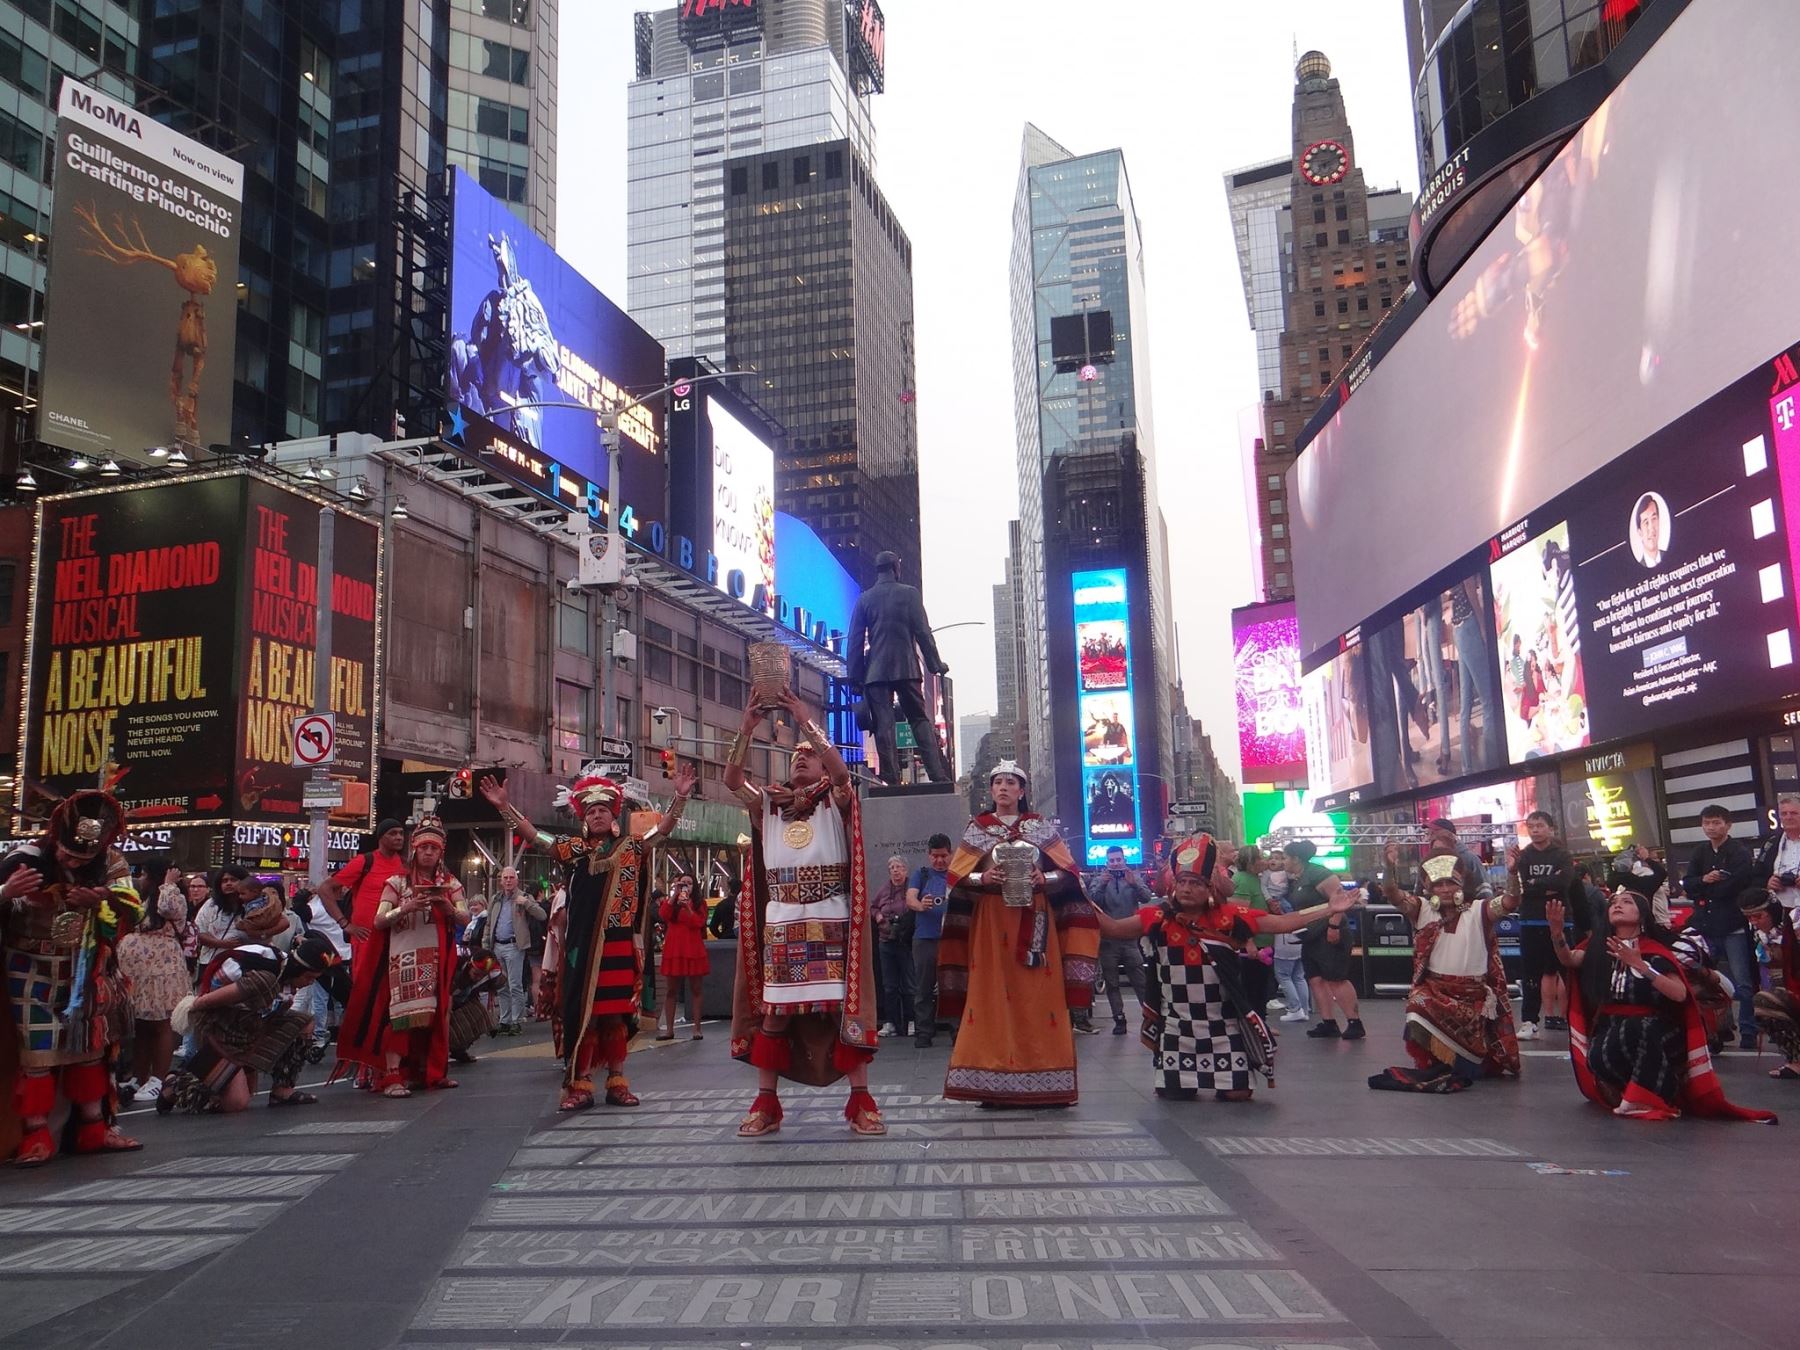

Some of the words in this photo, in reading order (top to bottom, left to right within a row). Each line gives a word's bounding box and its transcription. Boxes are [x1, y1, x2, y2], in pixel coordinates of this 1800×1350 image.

[71, 88, 142, 139] MoMA
[67, 133, 159, 187] Guillermo
[161, 179, 188, 202] del
[191, 190, 232, 223] Toro:
[173, 147, 195, 166] Now
[197, 162, 210, 173] on
[211, 165, 235, 185] view
[1420, 147, 1470, 209] MARRIOTT
[66, 152, 145, 202] Crafting
[147, 188, 230, 238] Pinocchio
[1421, 172, 1464, 225] MARQUIS
[674, 400, 690, 411] LG
[48, 411, 89, 429] CHANEL
[715, 445, 732, 475] DID
[717, 484, 737, 513] YOU
[60, 514, 98, 558] THE
[257, 504, 288, 554] THE
[1501, 519, 1528, 541] MARRIOTT
[1502, 532, 1526, 552] MARQUIS
[55, 556, 103, 602] NEIL
[108, 541, 220, 597] DIAMOND
[254, 547, 294, 599] NEIL
[297, 562, 374, 622] DIMOND
[1626, 588, 1636, 600] for
[1636, 582, 1650, 596] civil
[1650, 573, 1669, 590] rights
[1669, 562, 1698, 581] requires
[1698, 552, 1714, 568] that
[1714, 549, 1726, 561] we
[1592, 618, 1606, 632] pass
[1609, 603, 1634, 623] brightly
[1660, 590, 1668, 601] to
[1668, 584, 1680, 597] the
[1680, 579, 1696, 593] next
[1696, 562, 1736, 588] generation
[52, 595, 141, 645] MUSICAL
[253, 590, 317, 646] MUSICA
[1611, 625, 1621, 638] for
[1621, 619, 1637, 634] them
[1637, 617, 1645, 627] to
[1645, 607, 1673, 625] continue
[1673, 602, 1685, 613] our
[1685, 589, 1713, 610] journey
[1609, 637, 1634, 654] towards
[1634, 627, 1660, 645] fairness
[1659, 620, 1672, 634] and
[1672, 615, 1695, 631] equity
[1694, 610, 1705, 623] for
[45, 651, 62, 711] A
[69, 636, 207, 710] BEAUTIFUL
[249, 637, 262, 698] A
[268, 641, 366, 717] BEAUIFUL
[145, 713, 173, 723] SONGS
[174, 712, 191, 720] YOU
[192, 709, 219, 719] KNOW.
[41, 709, 118, 777] NOISE
[127, 737, 154, 746] NEVER
[155, 735, 184, 743] HEARD,
[145, 727, 171, 736] STORY
[245, 699, 306, 766] NOIS
[127, 750, 150, 759] UNTIL
[151, 749, 172, 757] NOW.
[605, 743, 616, 752] ONE
[610, 764, 628, 772] WAY
[1585, 752, 1625, 773] INVICTA
[139, 796, 189, 808] THEATRE
[235, 826, 281, 846] GIFTS
[677, 816, 696, 830] store
[1529, 865, 1553, 876] 1977
[1205, 1137, 1532, 1156] HIRSCHFELD
[904, 1162, 1177, 1183] IMPERIAL
[579, 1192, 953, 1220] FONTANNE
[976, 1190, 1210, 1201] BROOKS
[977, 1200, 1222, 1215] ATKINSON
[471, 1232, 586, 1248] ETHEL
[597, 1229, 936, 1245] BARRYMORE
[962, 1226, 1179, 1236] SAMUEL
[1194, 1225, 1242, 1235] J.
[459, 1246, 939, 1265] LONGACRE
[962, 1236, 1265, 1259] FRIEDMAN
[519, 1277, 844, 1323] KERR
[971, 1273, 1326, 1319] O'NEILL
